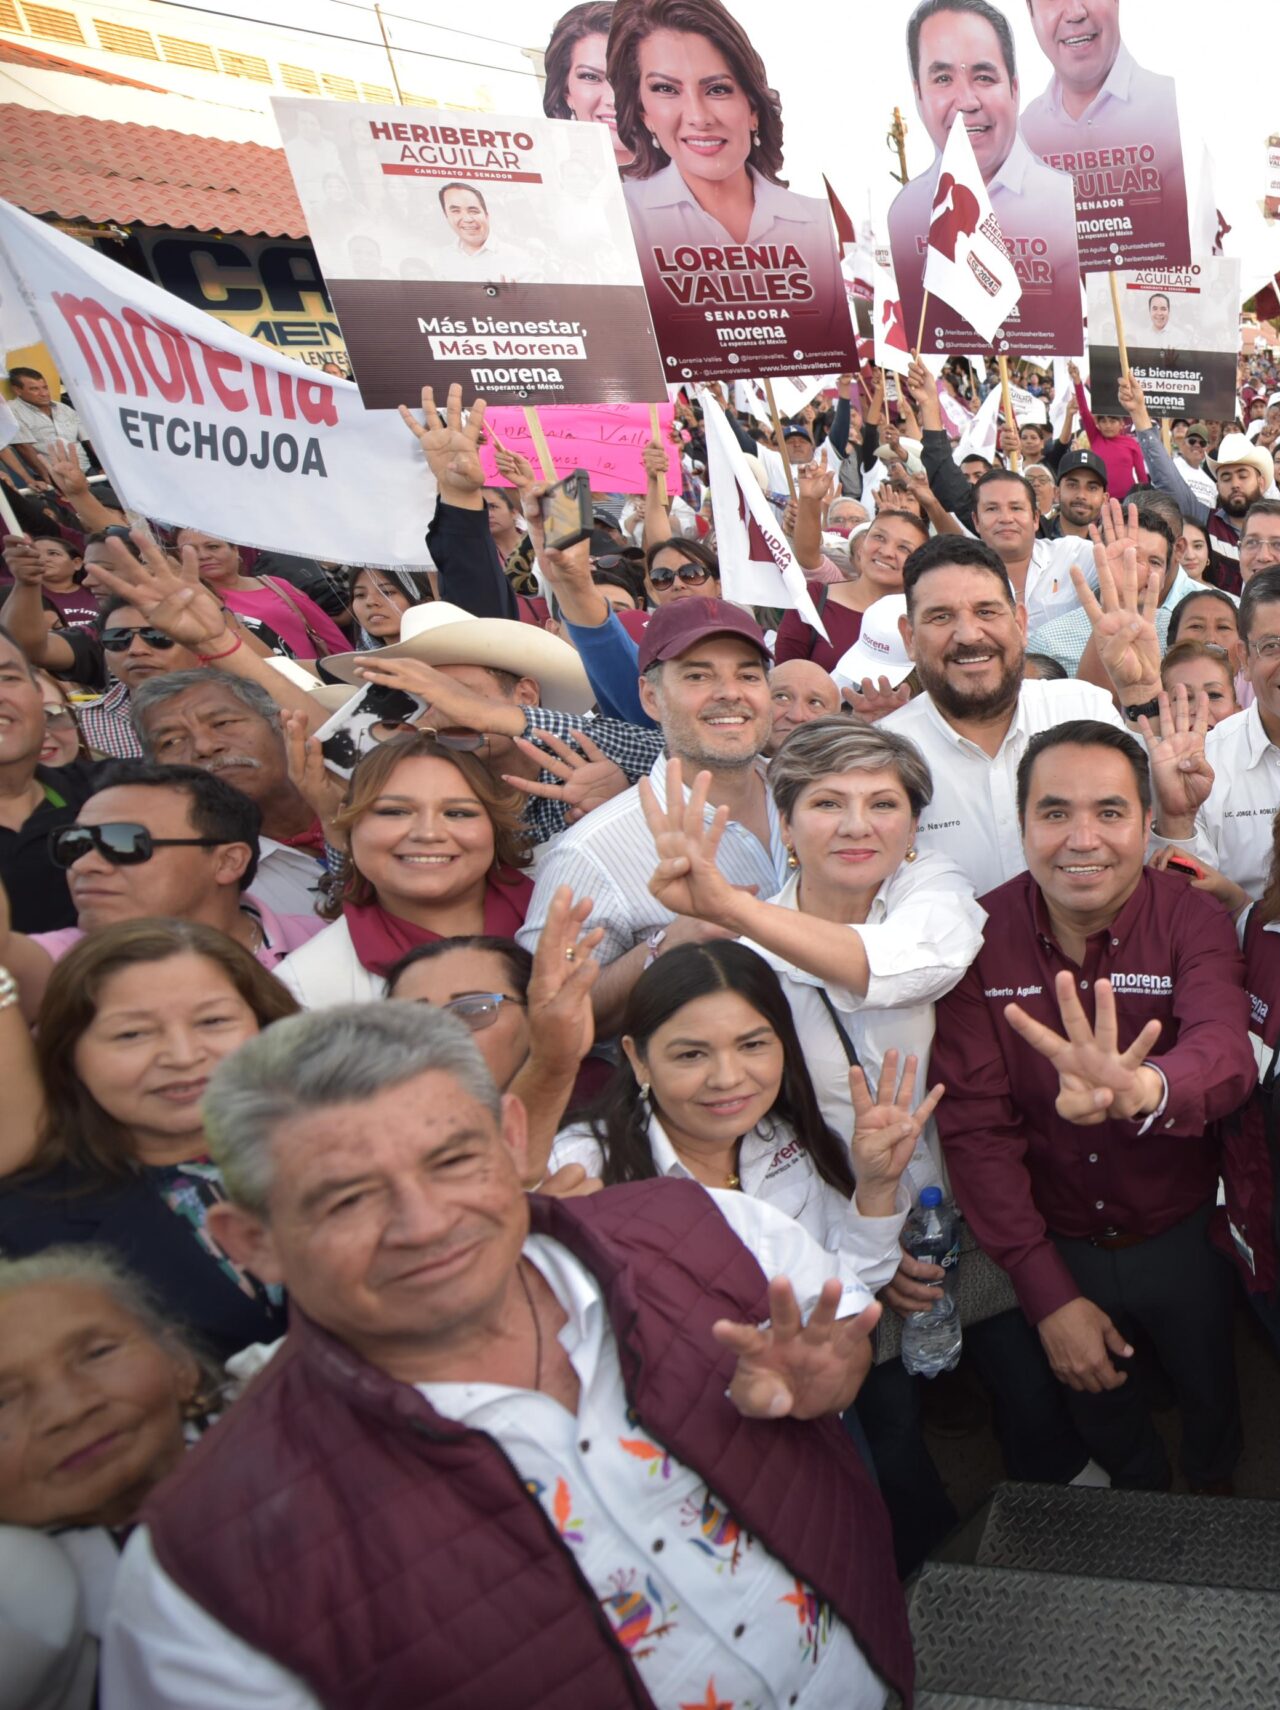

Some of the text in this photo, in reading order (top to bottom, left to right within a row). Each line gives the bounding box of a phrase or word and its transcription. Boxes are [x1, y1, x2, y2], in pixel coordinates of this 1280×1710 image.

[369, 121, 534, 150] HERIBERTO
[400, 144, 521, 170] AGUILAR
[414, 168, 513, 180] CANDIDATO A SENADOR
[1076, 198, 1125, 211] SENADOR
[1076, 216, 1133, 234] morena
[653, 245, 809, 273] LORENIA
[1135, 272, 1192, 287] AGUILAR
[662, 273, 815, 306] VALLES
[704, 308, 790, 322] SENADORA
[417, 317, 587, 337] Más bienestar,
[716, 325, 786, 341] morena
[439, 340, 579, 356] Más Morena
[51, 291, 339, 427] morena
[470, 367, 563, 384] morena
[1148, 367, 1203, 381] bienestar,
[1156, 382, 1197, 392] Morena
[1144, 395, 1185, 406] morena
[119, 407, 328, 478] ETCHOJOA
[862, 632, 890, 652] morena
[928, 820, 961, 831] Navarro
[1110, 972, 1173, 989] morena
[1016, 986, 1043, 997] Aguilar
[1118, 987, 1144, 995] esperanza
[1152, 988, 1173, 996] México
